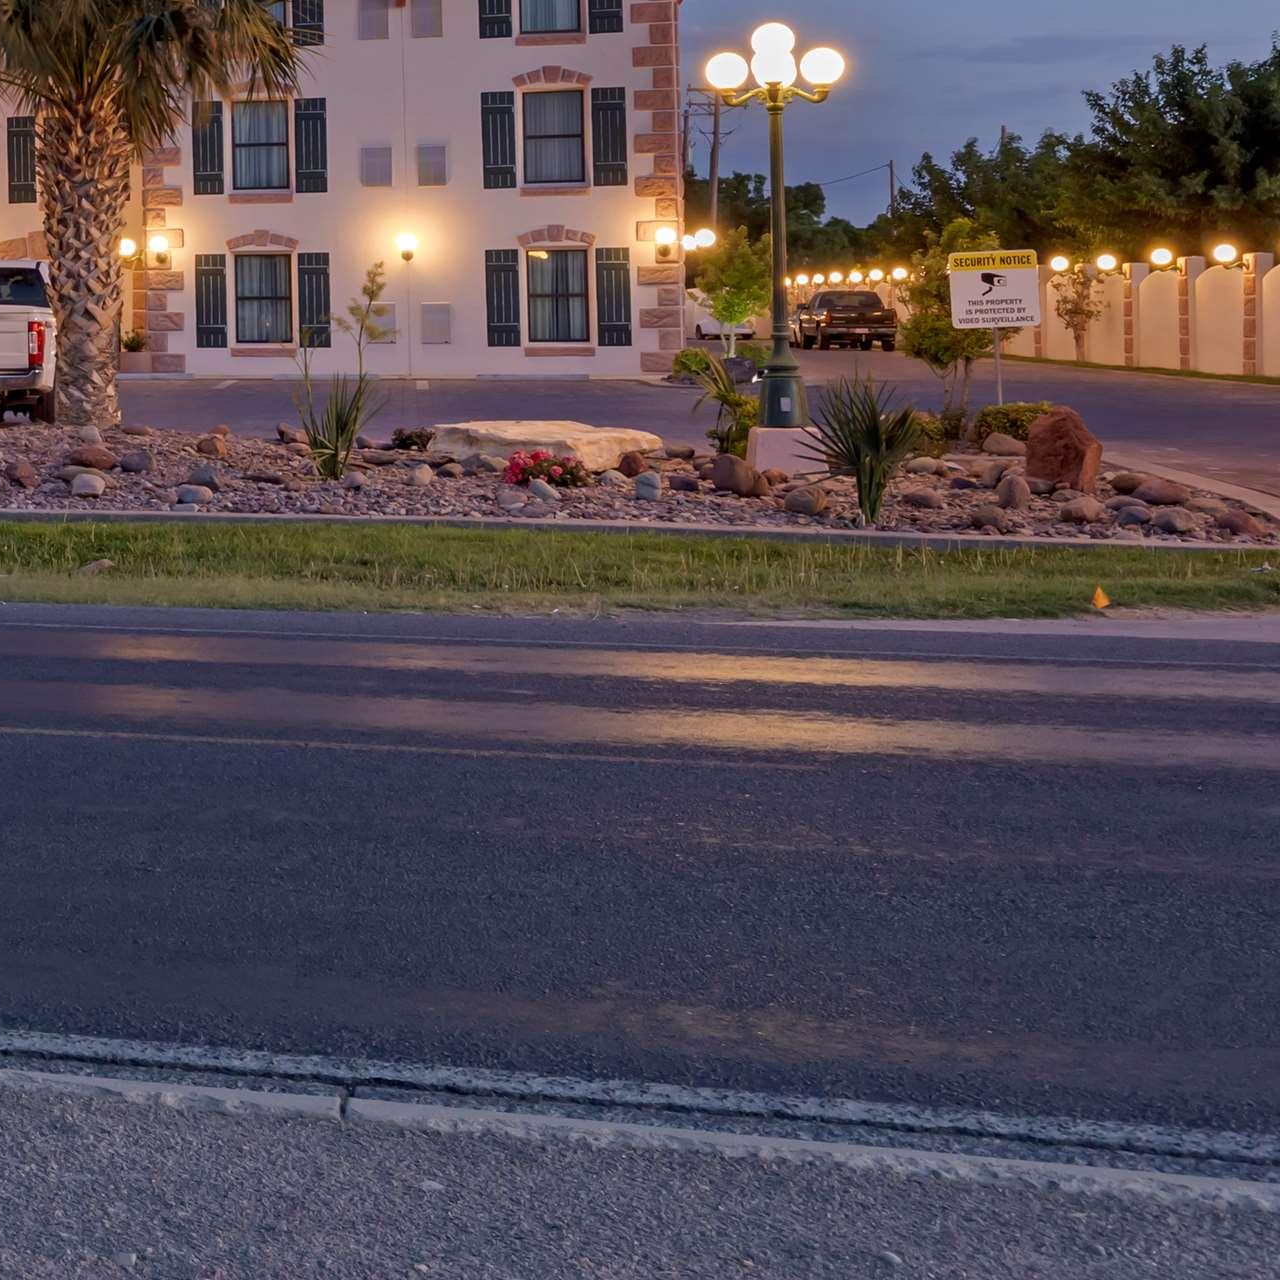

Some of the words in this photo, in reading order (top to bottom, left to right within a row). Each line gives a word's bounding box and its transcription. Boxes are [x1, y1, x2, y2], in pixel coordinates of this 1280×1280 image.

[953, 256, 996, 267] SECURITY
[1000, 254, 1032, 265] NOTICE
[985, 298, 1023, 306] PROPERTY
[974, 307, 1015, 315] PROTECTED
